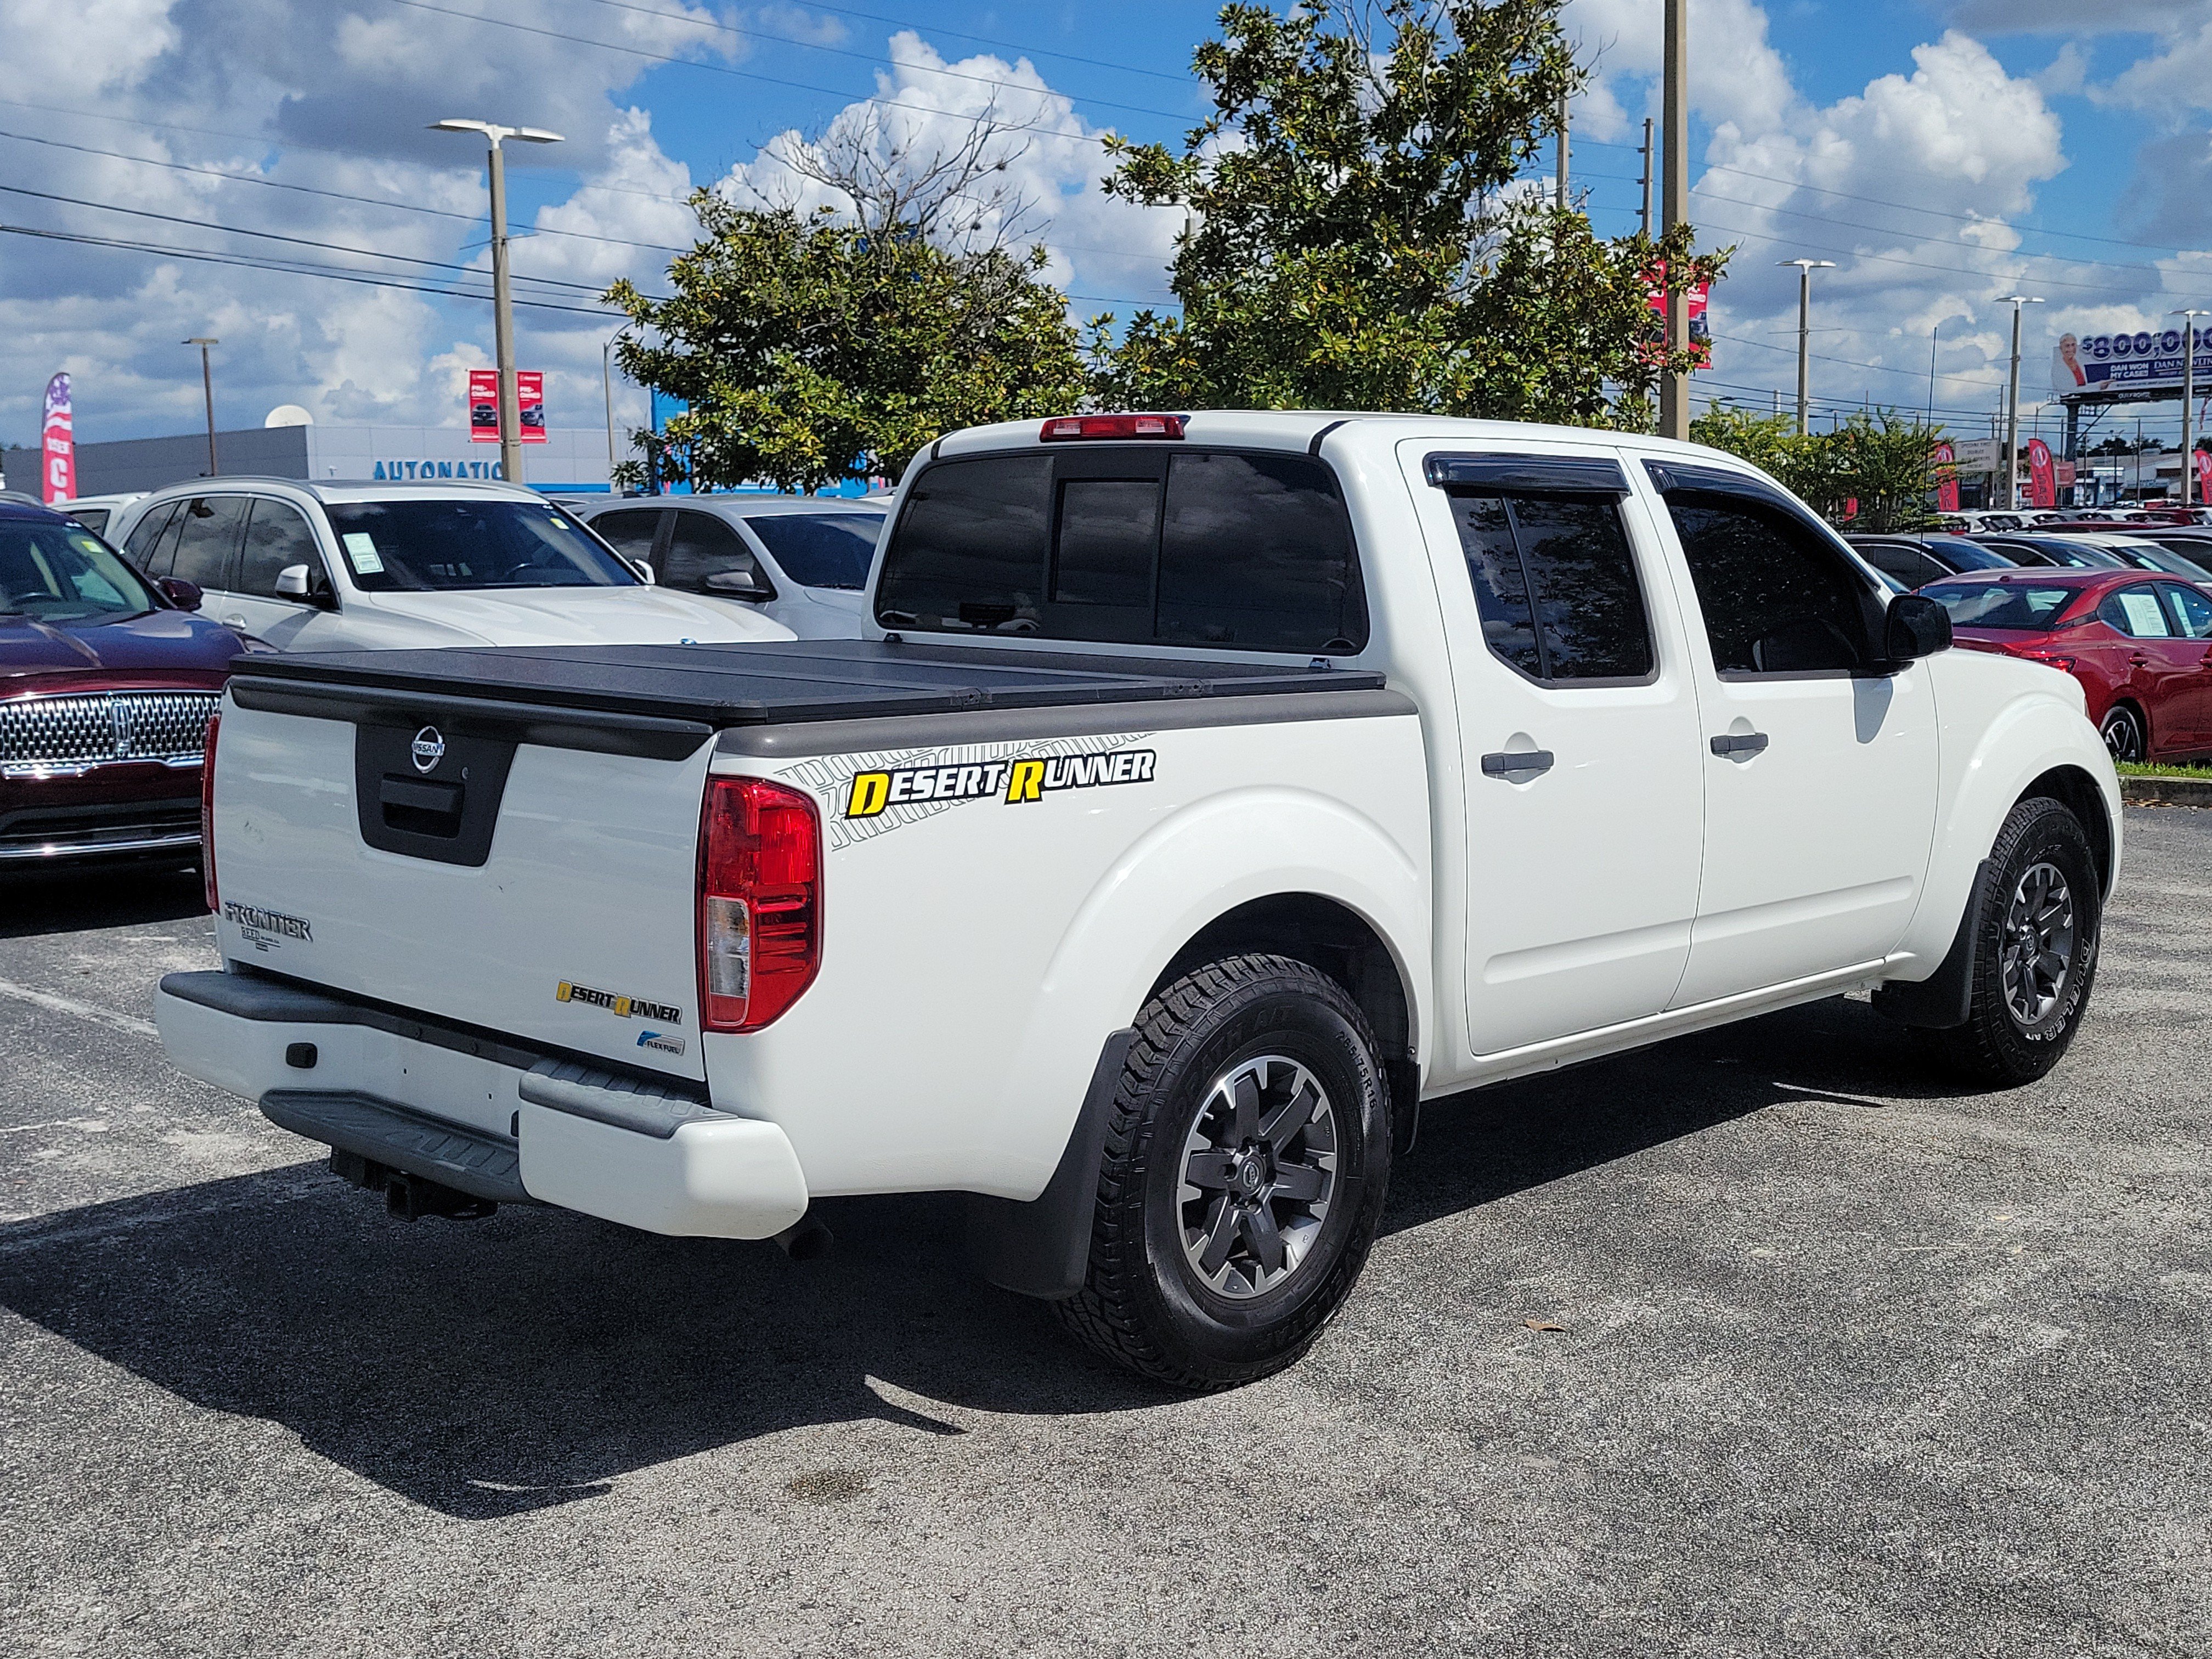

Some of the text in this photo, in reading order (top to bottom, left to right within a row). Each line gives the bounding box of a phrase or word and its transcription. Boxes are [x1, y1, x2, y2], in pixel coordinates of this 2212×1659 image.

[2111, 364, 2128, 372] DAN
[2154, 357, 2212, 369] DAN NWLIN
[373, 461, 504, 481] AUTONATIO
[847, 749, 1155, 817] DESERT RUNNER
[224, 900, 313, 943] FRONTIER
[556, 980, 682, 1025] DESERT RUNNER
[2044, 938, 2091, 1041] DUELER
[647, 1040, 680, 1054] FLEX FUEL
